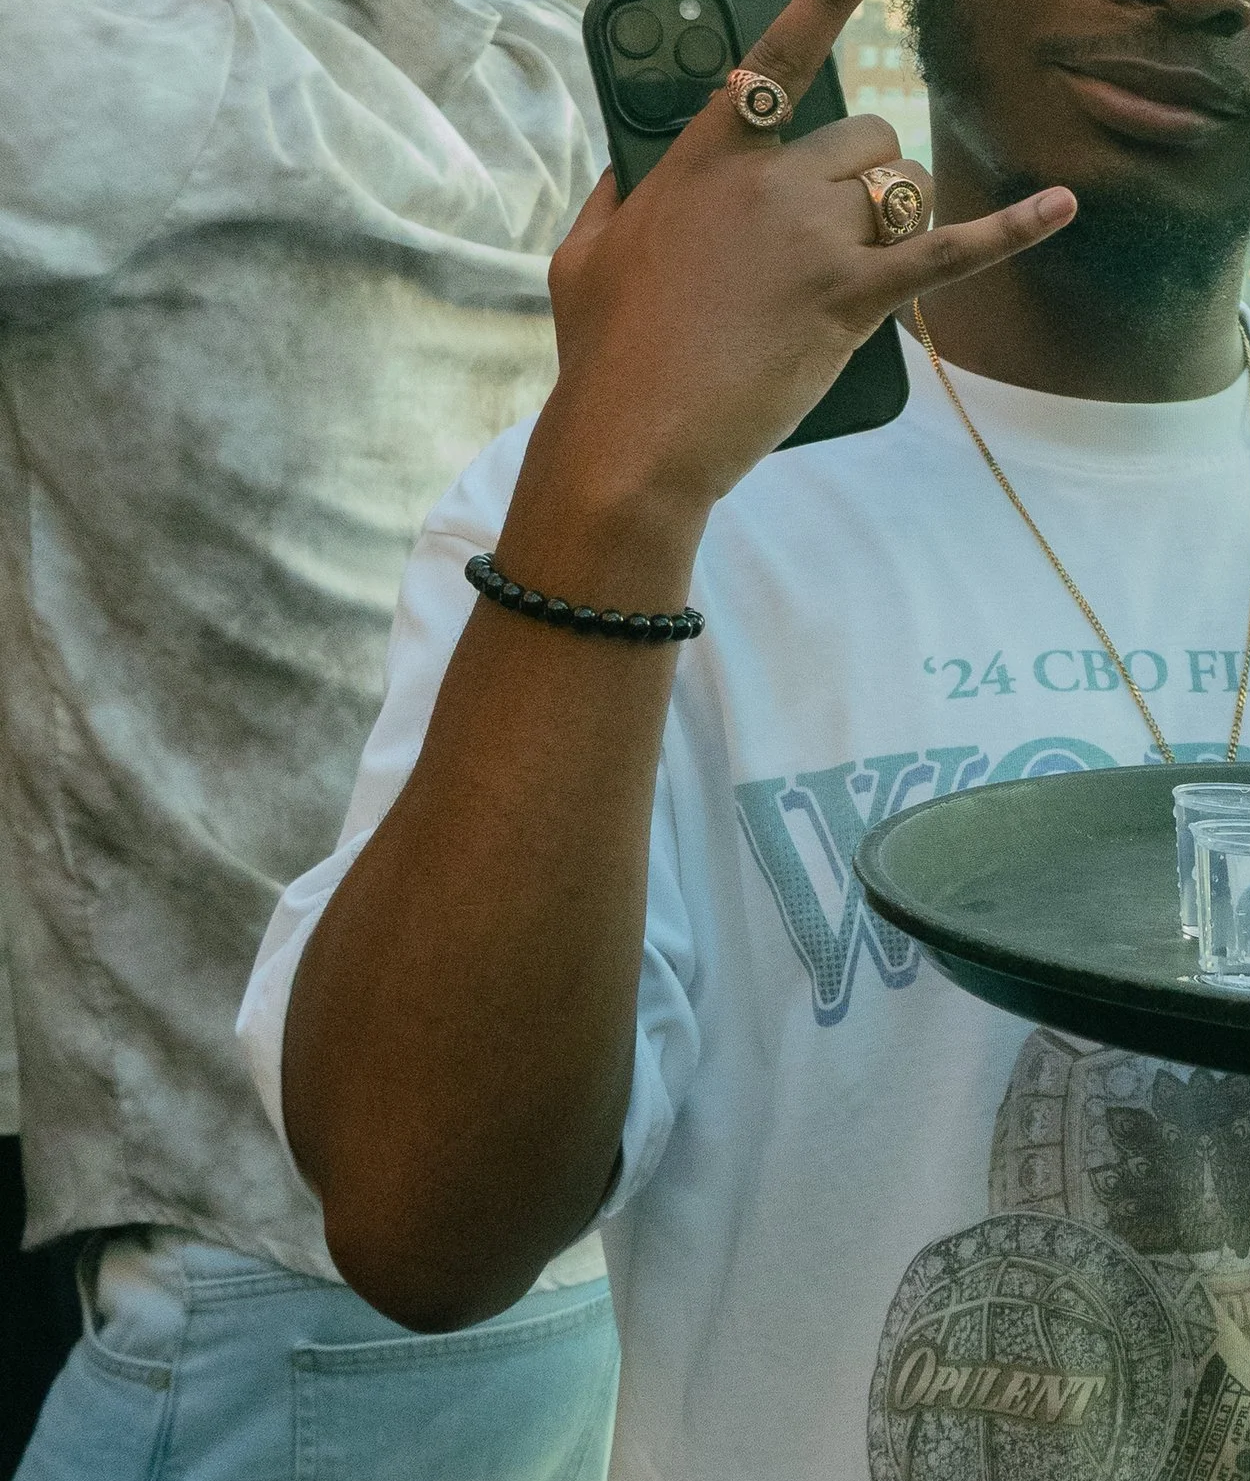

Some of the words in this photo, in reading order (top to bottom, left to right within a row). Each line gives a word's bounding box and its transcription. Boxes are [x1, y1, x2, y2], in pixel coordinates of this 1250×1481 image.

[1033, 648, 1169, 694] CBO
[895, 1346, 1107, 1426] OPULENT
[1205, 1403, 1233, 1455] WORLD
